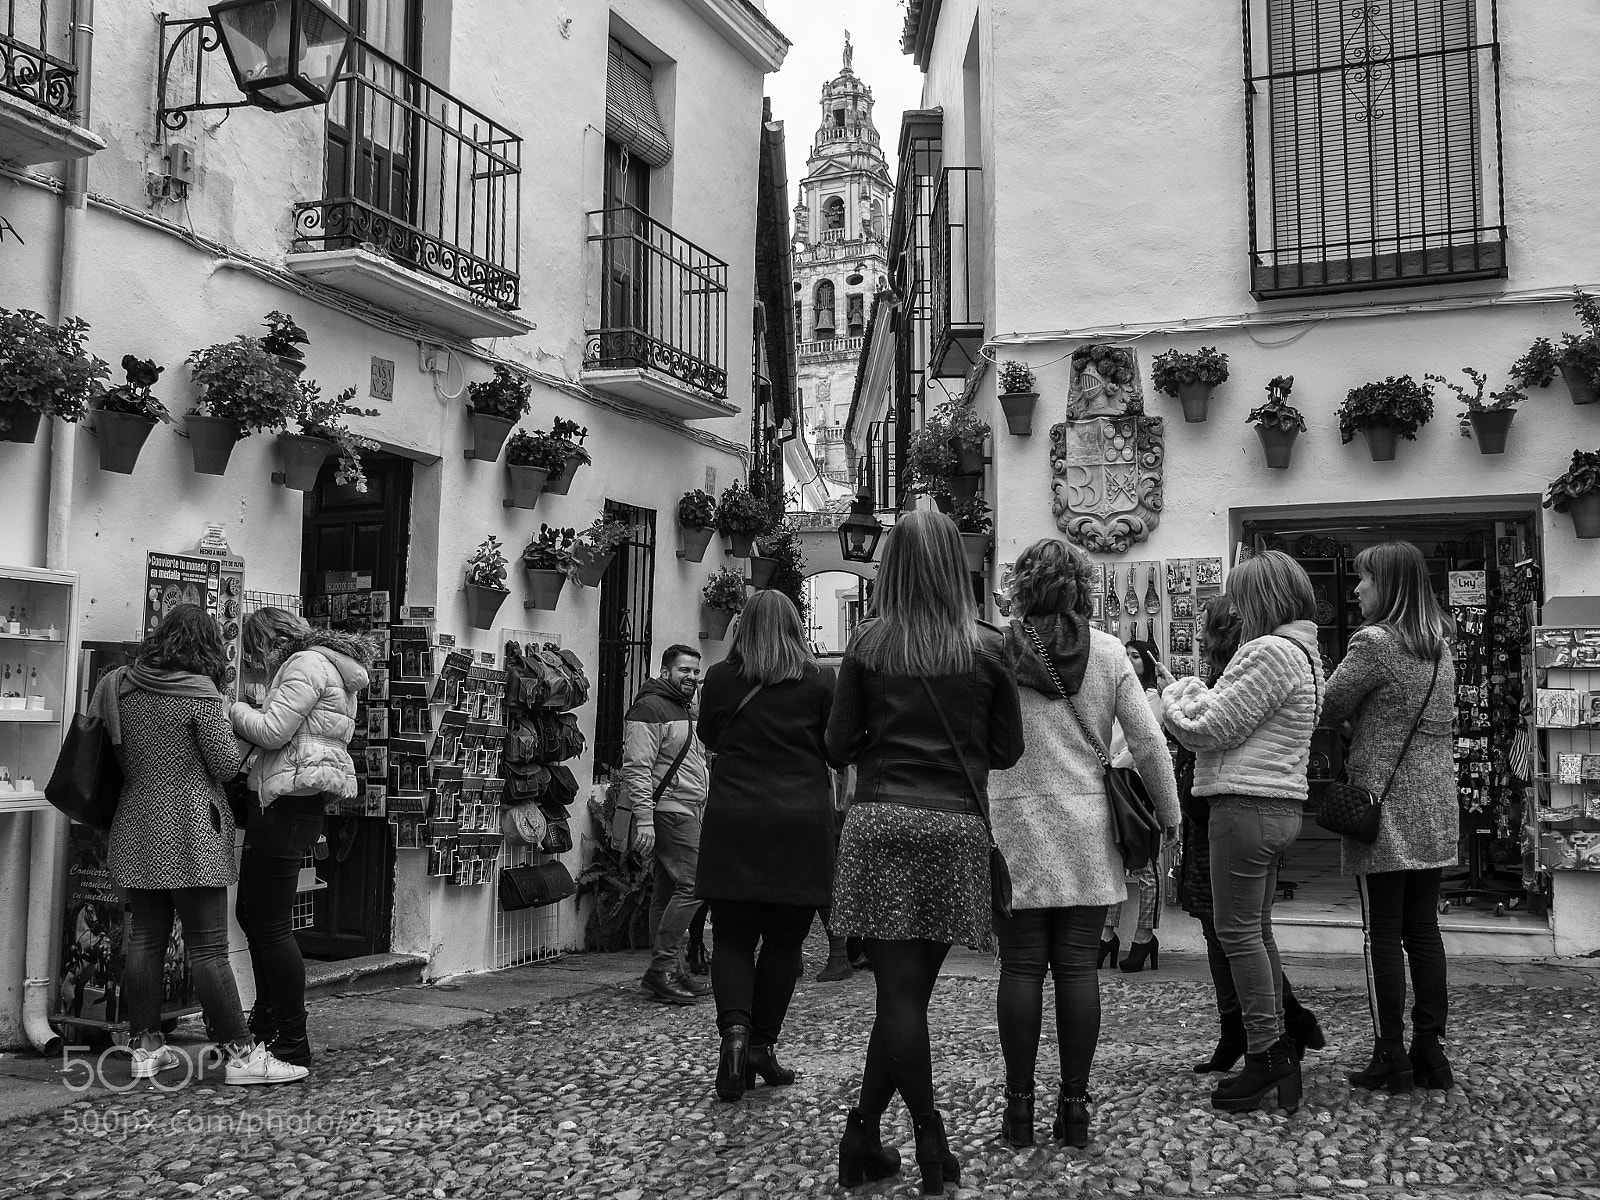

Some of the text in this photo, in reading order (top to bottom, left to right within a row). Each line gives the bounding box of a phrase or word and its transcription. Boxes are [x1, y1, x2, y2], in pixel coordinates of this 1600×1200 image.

[151, 555, 207, 573] Convierte tu moneda
[151, 568, 158, 578] en
[158, 569, 181, 581] medalla
[70, 863, 110, 878] Convierte
[80, 880, 112, 890] moneda
[84, 893, 119, 903] medalla
